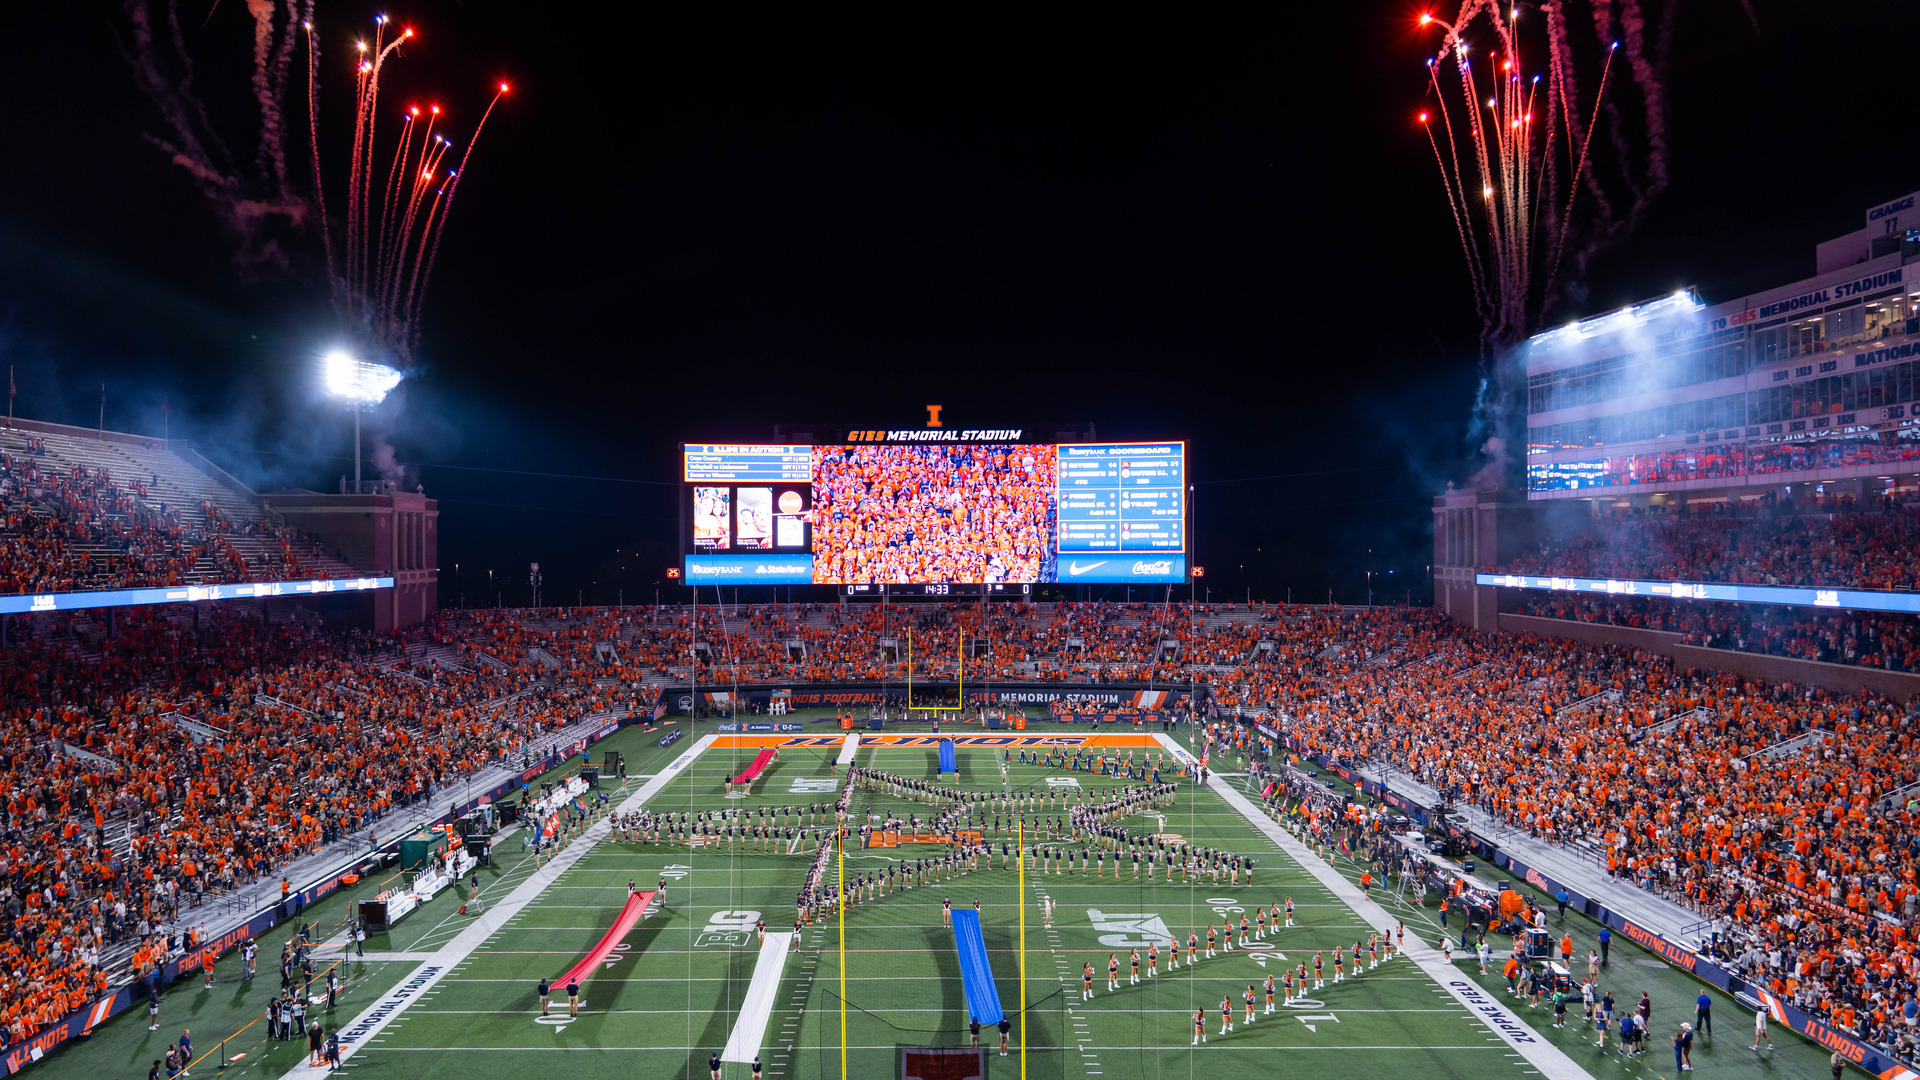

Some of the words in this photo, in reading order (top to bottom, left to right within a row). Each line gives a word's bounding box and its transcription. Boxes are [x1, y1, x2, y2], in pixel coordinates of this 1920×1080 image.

[1869, 196, 1915, 221] GRANGE
[1884, 216, 1898, 234] 77
[1710, 317, 1727, 331] TO
[1729, 309, 1757, 326] GIES
[1759, 289, 1831, 319] MEMORIAL
[1834, 269, 1903, 299] STADIUM
[847, 430, 886, 442] GIES
[886, 430, 959, 441] MEMORIAL
[960, 429, 1022, 441] STADIUM
[750, 446, 785, 454] ACTION
[1109, 447, 1171, 455] SCOREBOARD
[668, 569, 679, 577] 25
[1192, 567, 1202, 576] 25
[847, 585, 854, 595] 0
[879, 584, 884, 592] 3
[925, 584, 949, 595] 14:33
[987, 583, 992, 592] 3
[1023, 584, 1030, 594] 0
[1001, 693, 1060, 703] MEMORIAL
[1066, 694, 1119, 704] STADIUM
[779, 736, 1089, 747] ILLINOIS
[178, 938, 224, 975] FIGHTG
[224, 924, 250, 949] ILLINI
[1622, 921, 1667, 954] FIGHTING
[1665, 944, 1697, 970] ILLINI
[1449, 981, 1490, 1004] FIELD
[337, 999, 405, 1044] MEMORIAL
[392, 965, 444, 999] STADIUM
[1477, 1006, 1537, 1044] ZUPPKE
[1804, 1019, 1866, 1063] ILLINOIS
